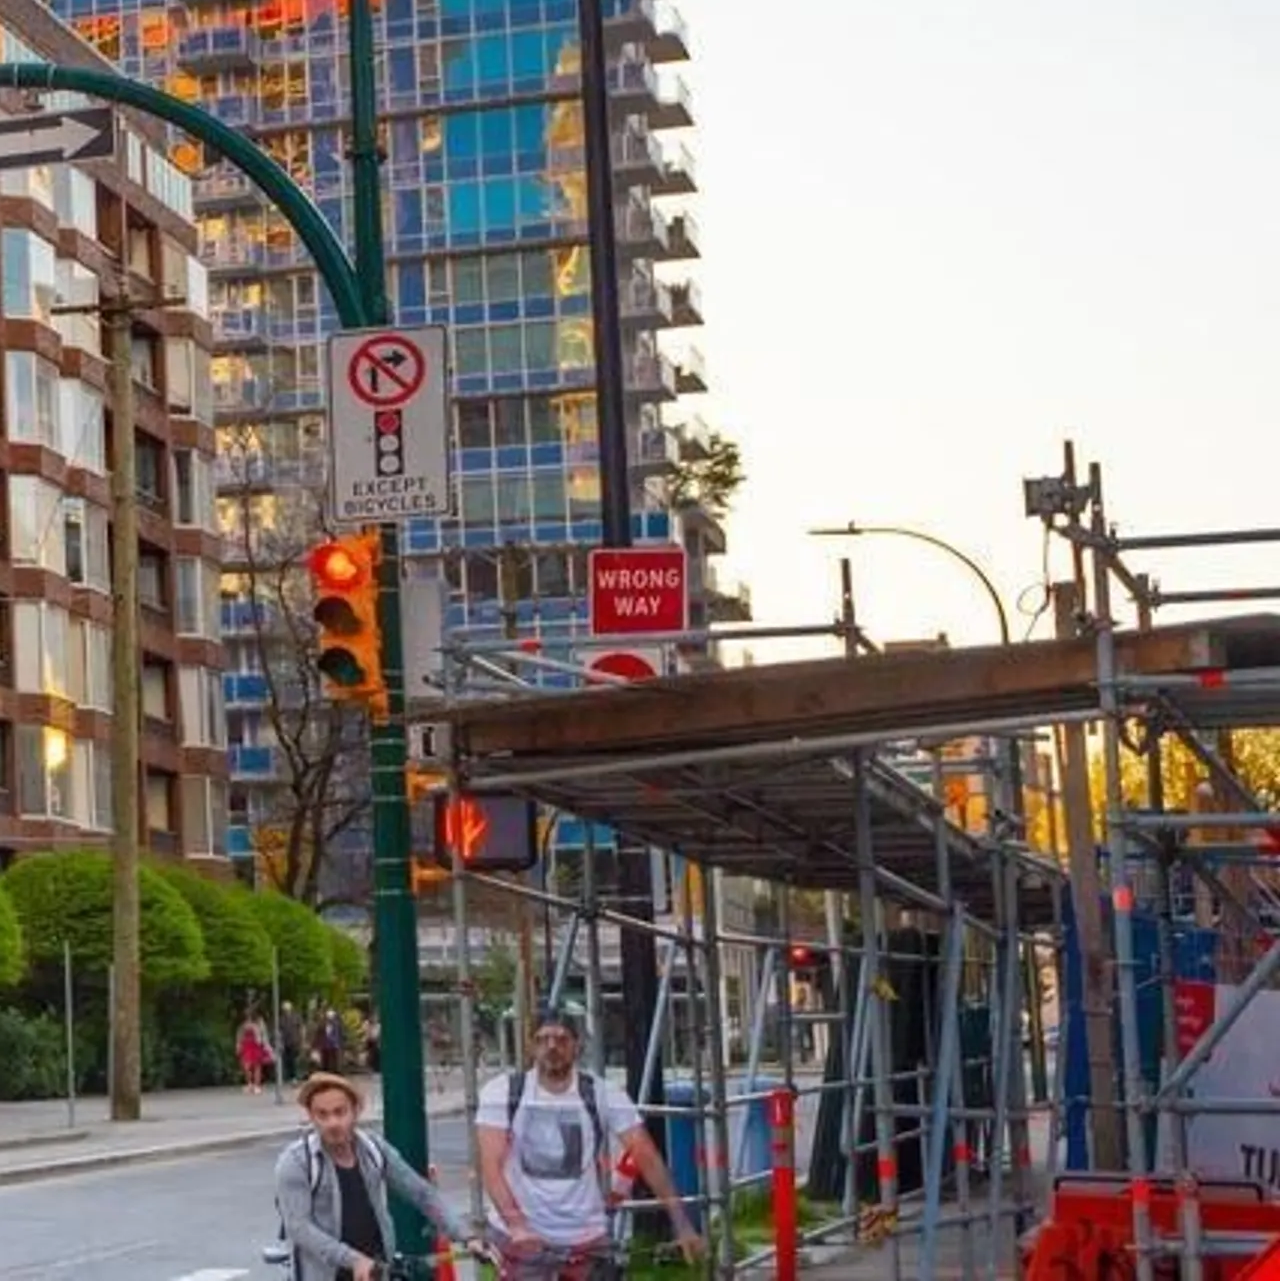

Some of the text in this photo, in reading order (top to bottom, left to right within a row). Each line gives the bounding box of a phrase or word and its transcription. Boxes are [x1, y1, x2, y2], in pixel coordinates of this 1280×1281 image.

[352, 476, 428, 497] EXCEPT
[344, 492, 438, 515] BICYCLES
[597, 568, 681, 590] WRONG
[613, 595, 662, 617] WAY
